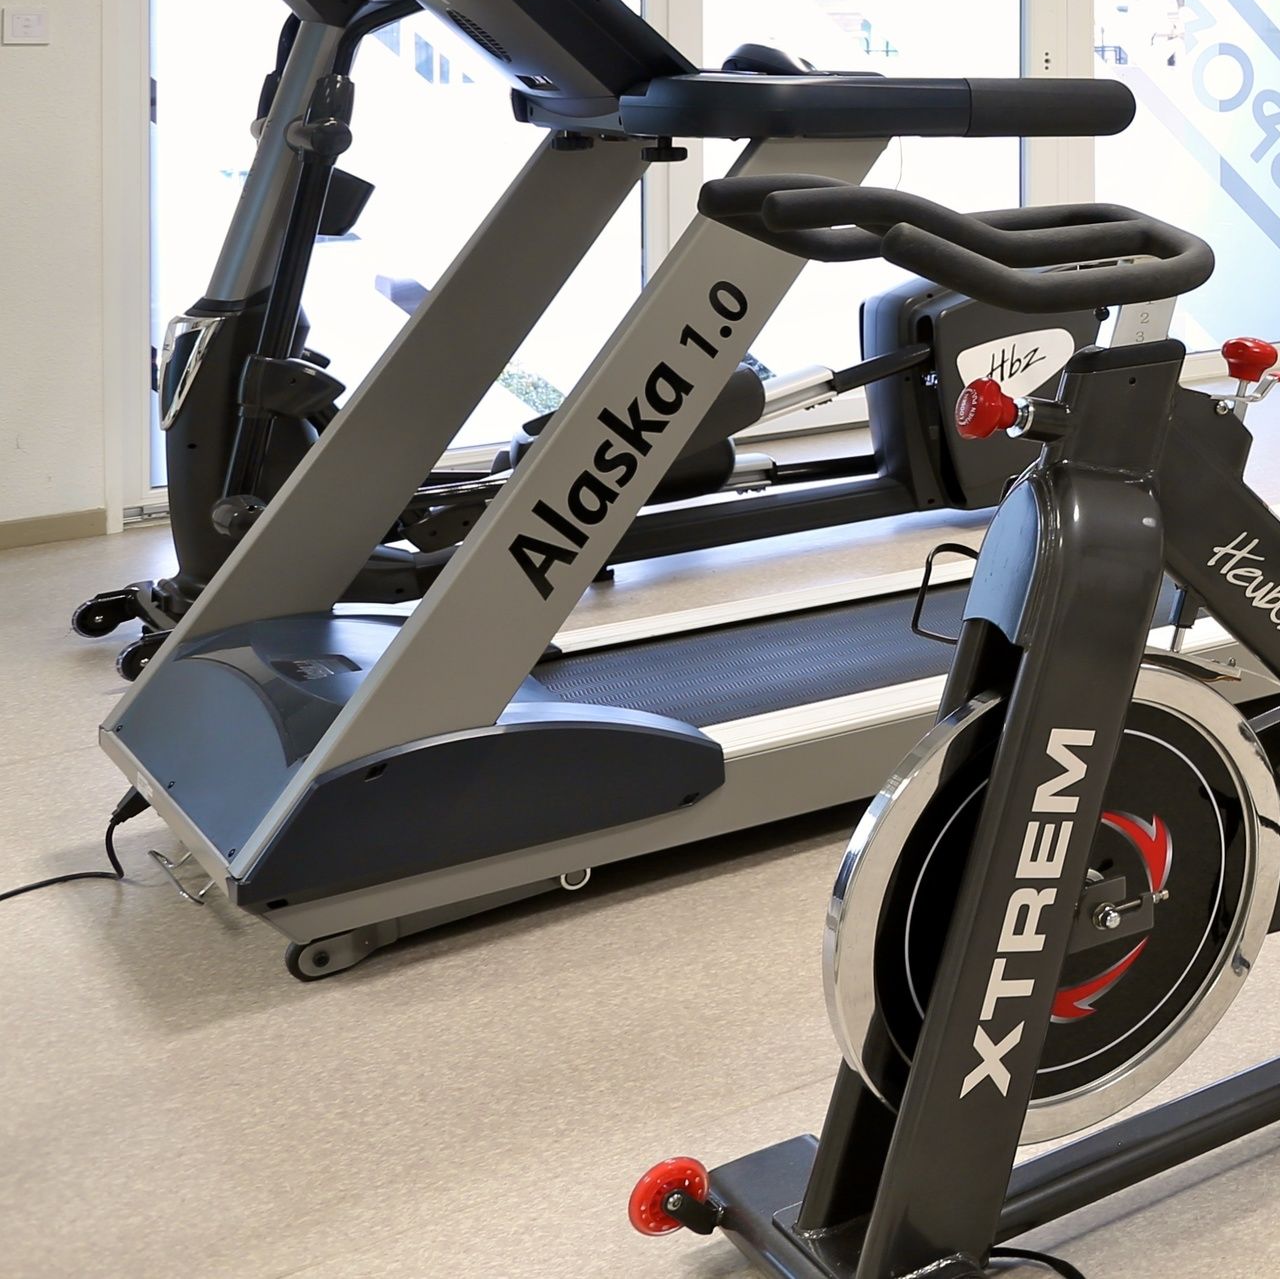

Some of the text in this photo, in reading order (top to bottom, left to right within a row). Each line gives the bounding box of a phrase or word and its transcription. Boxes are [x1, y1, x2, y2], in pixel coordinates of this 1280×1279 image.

[1135, 331, 1145, 342] 3
[1140, 312, 1150, 324] 2
[986, 343, 1046, 382] Hbz
[508, 280, 748, 601] Alaska 1.0
[959, 728, 1096, 1099] XTREM
